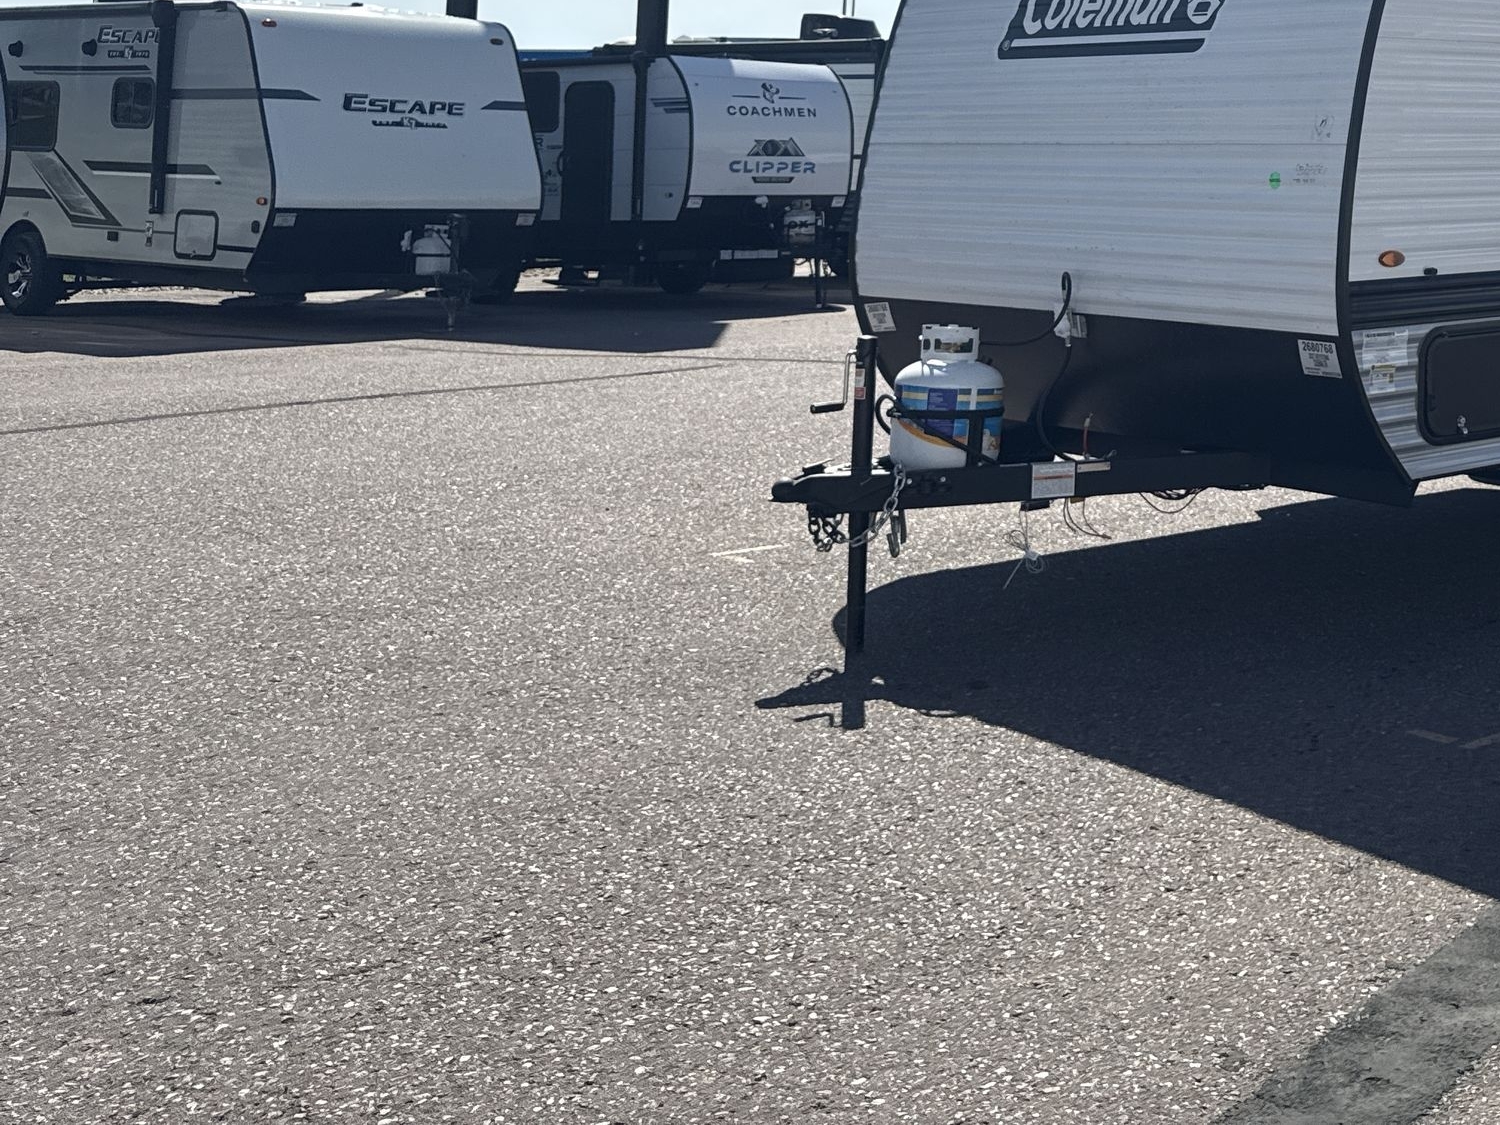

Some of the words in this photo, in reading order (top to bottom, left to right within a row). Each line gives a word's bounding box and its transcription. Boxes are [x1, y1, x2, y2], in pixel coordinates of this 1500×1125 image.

[342, 92, 466, 116] ESCAPE
[726, 105, 818, 118] COACHMEN
[729, 160, 816, 174] CLIPPER
